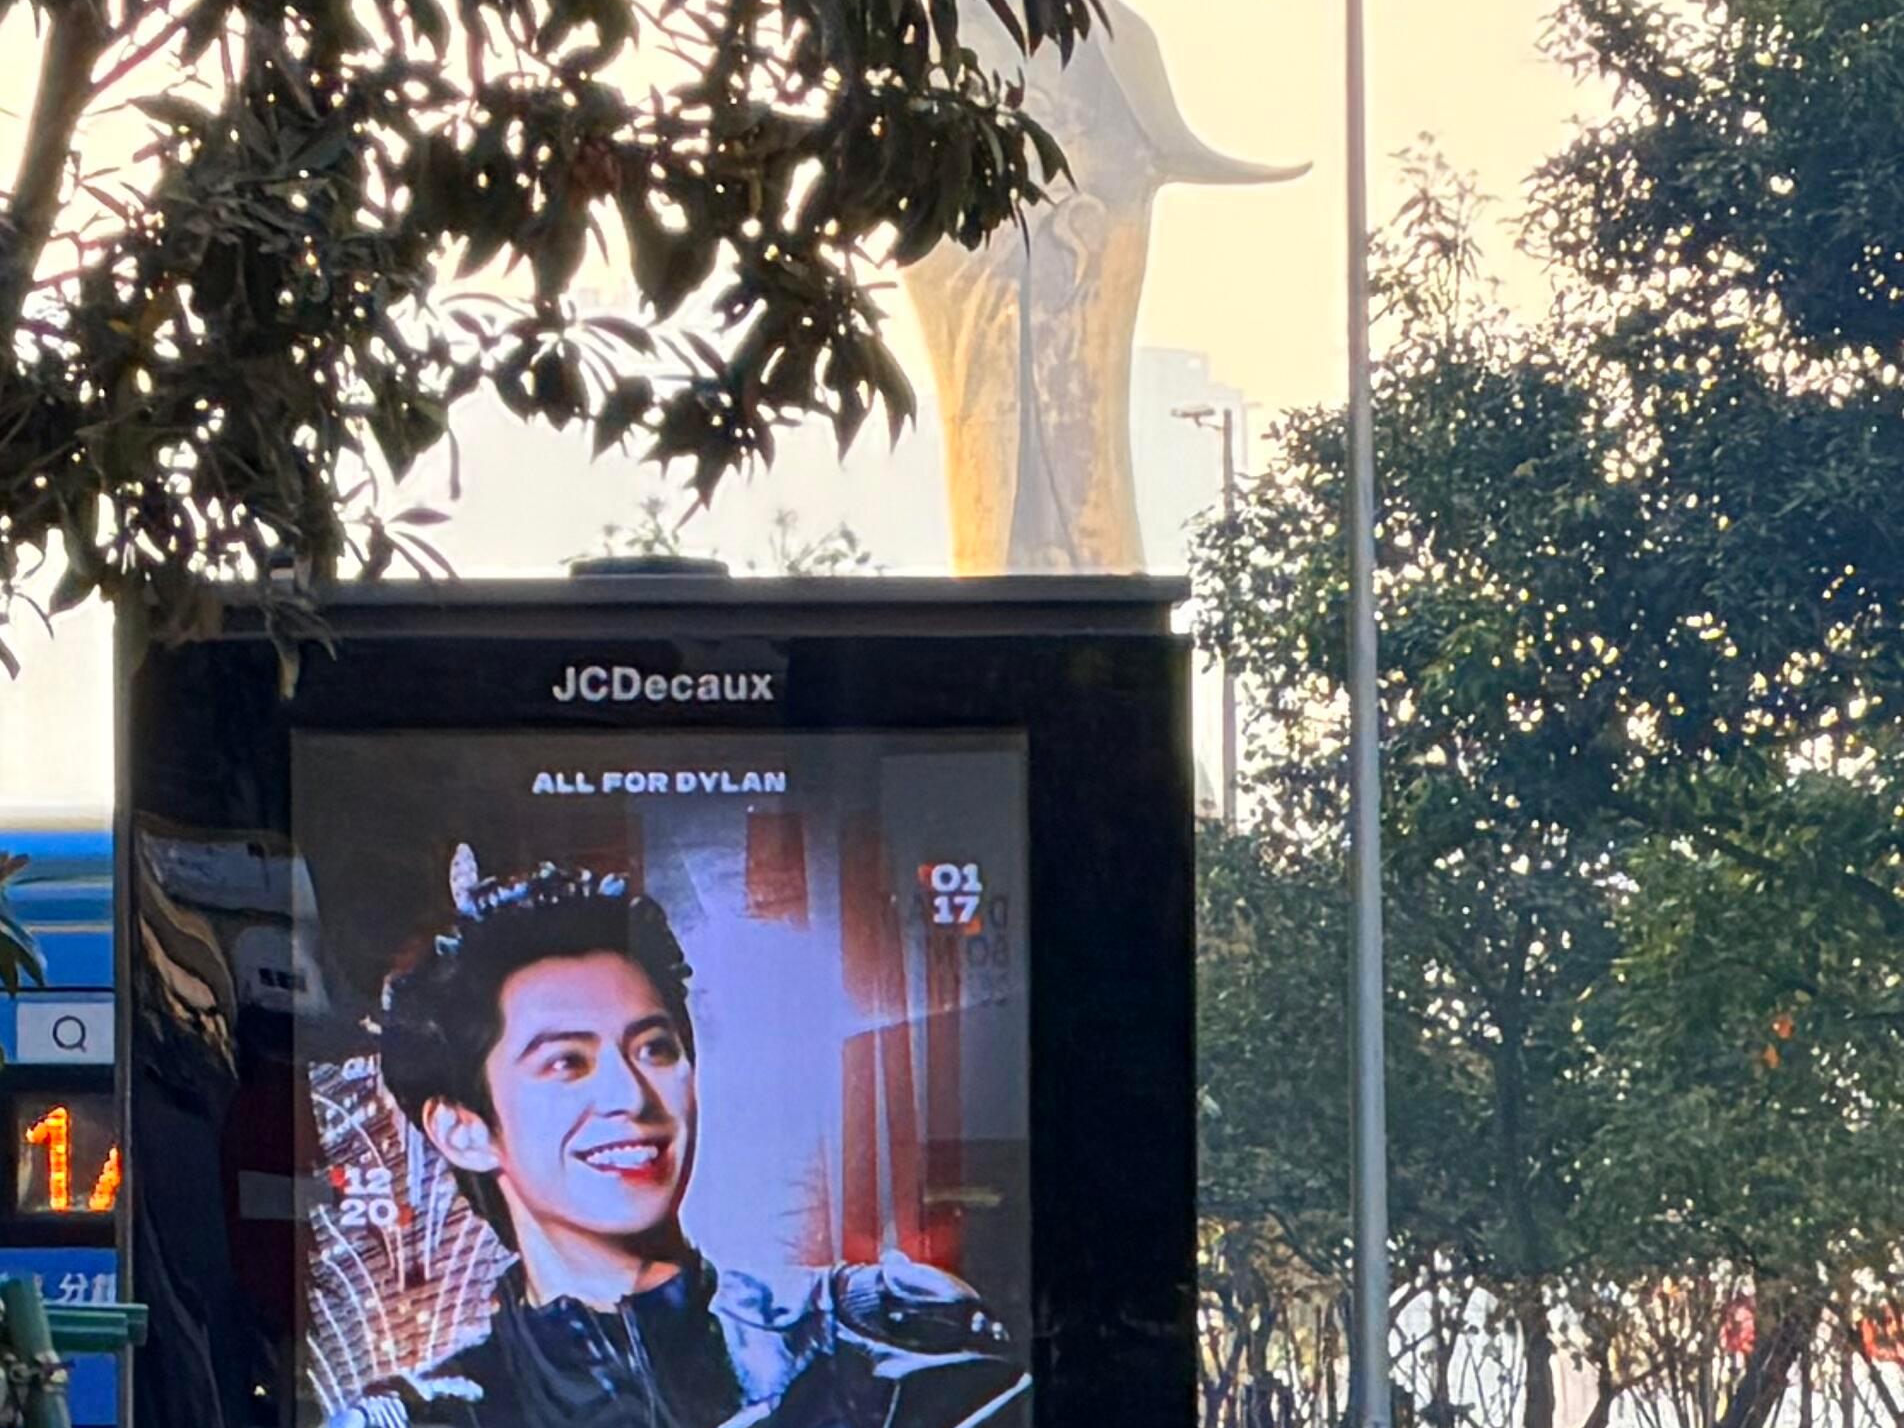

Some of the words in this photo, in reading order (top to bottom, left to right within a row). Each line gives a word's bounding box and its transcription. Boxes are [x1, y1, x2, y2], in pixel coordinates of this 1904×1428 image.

[552, 665, 774, 702] JCDecaux
[532, 771, 595, 794] ALL
[602, 771, 669, 793] FOR
[675, 771, 786, 793] DYLAN
[930, 863, 983, 892] 01
[933, 895, 980, 924] 17
[340, 1198, 399, 1226] 20
